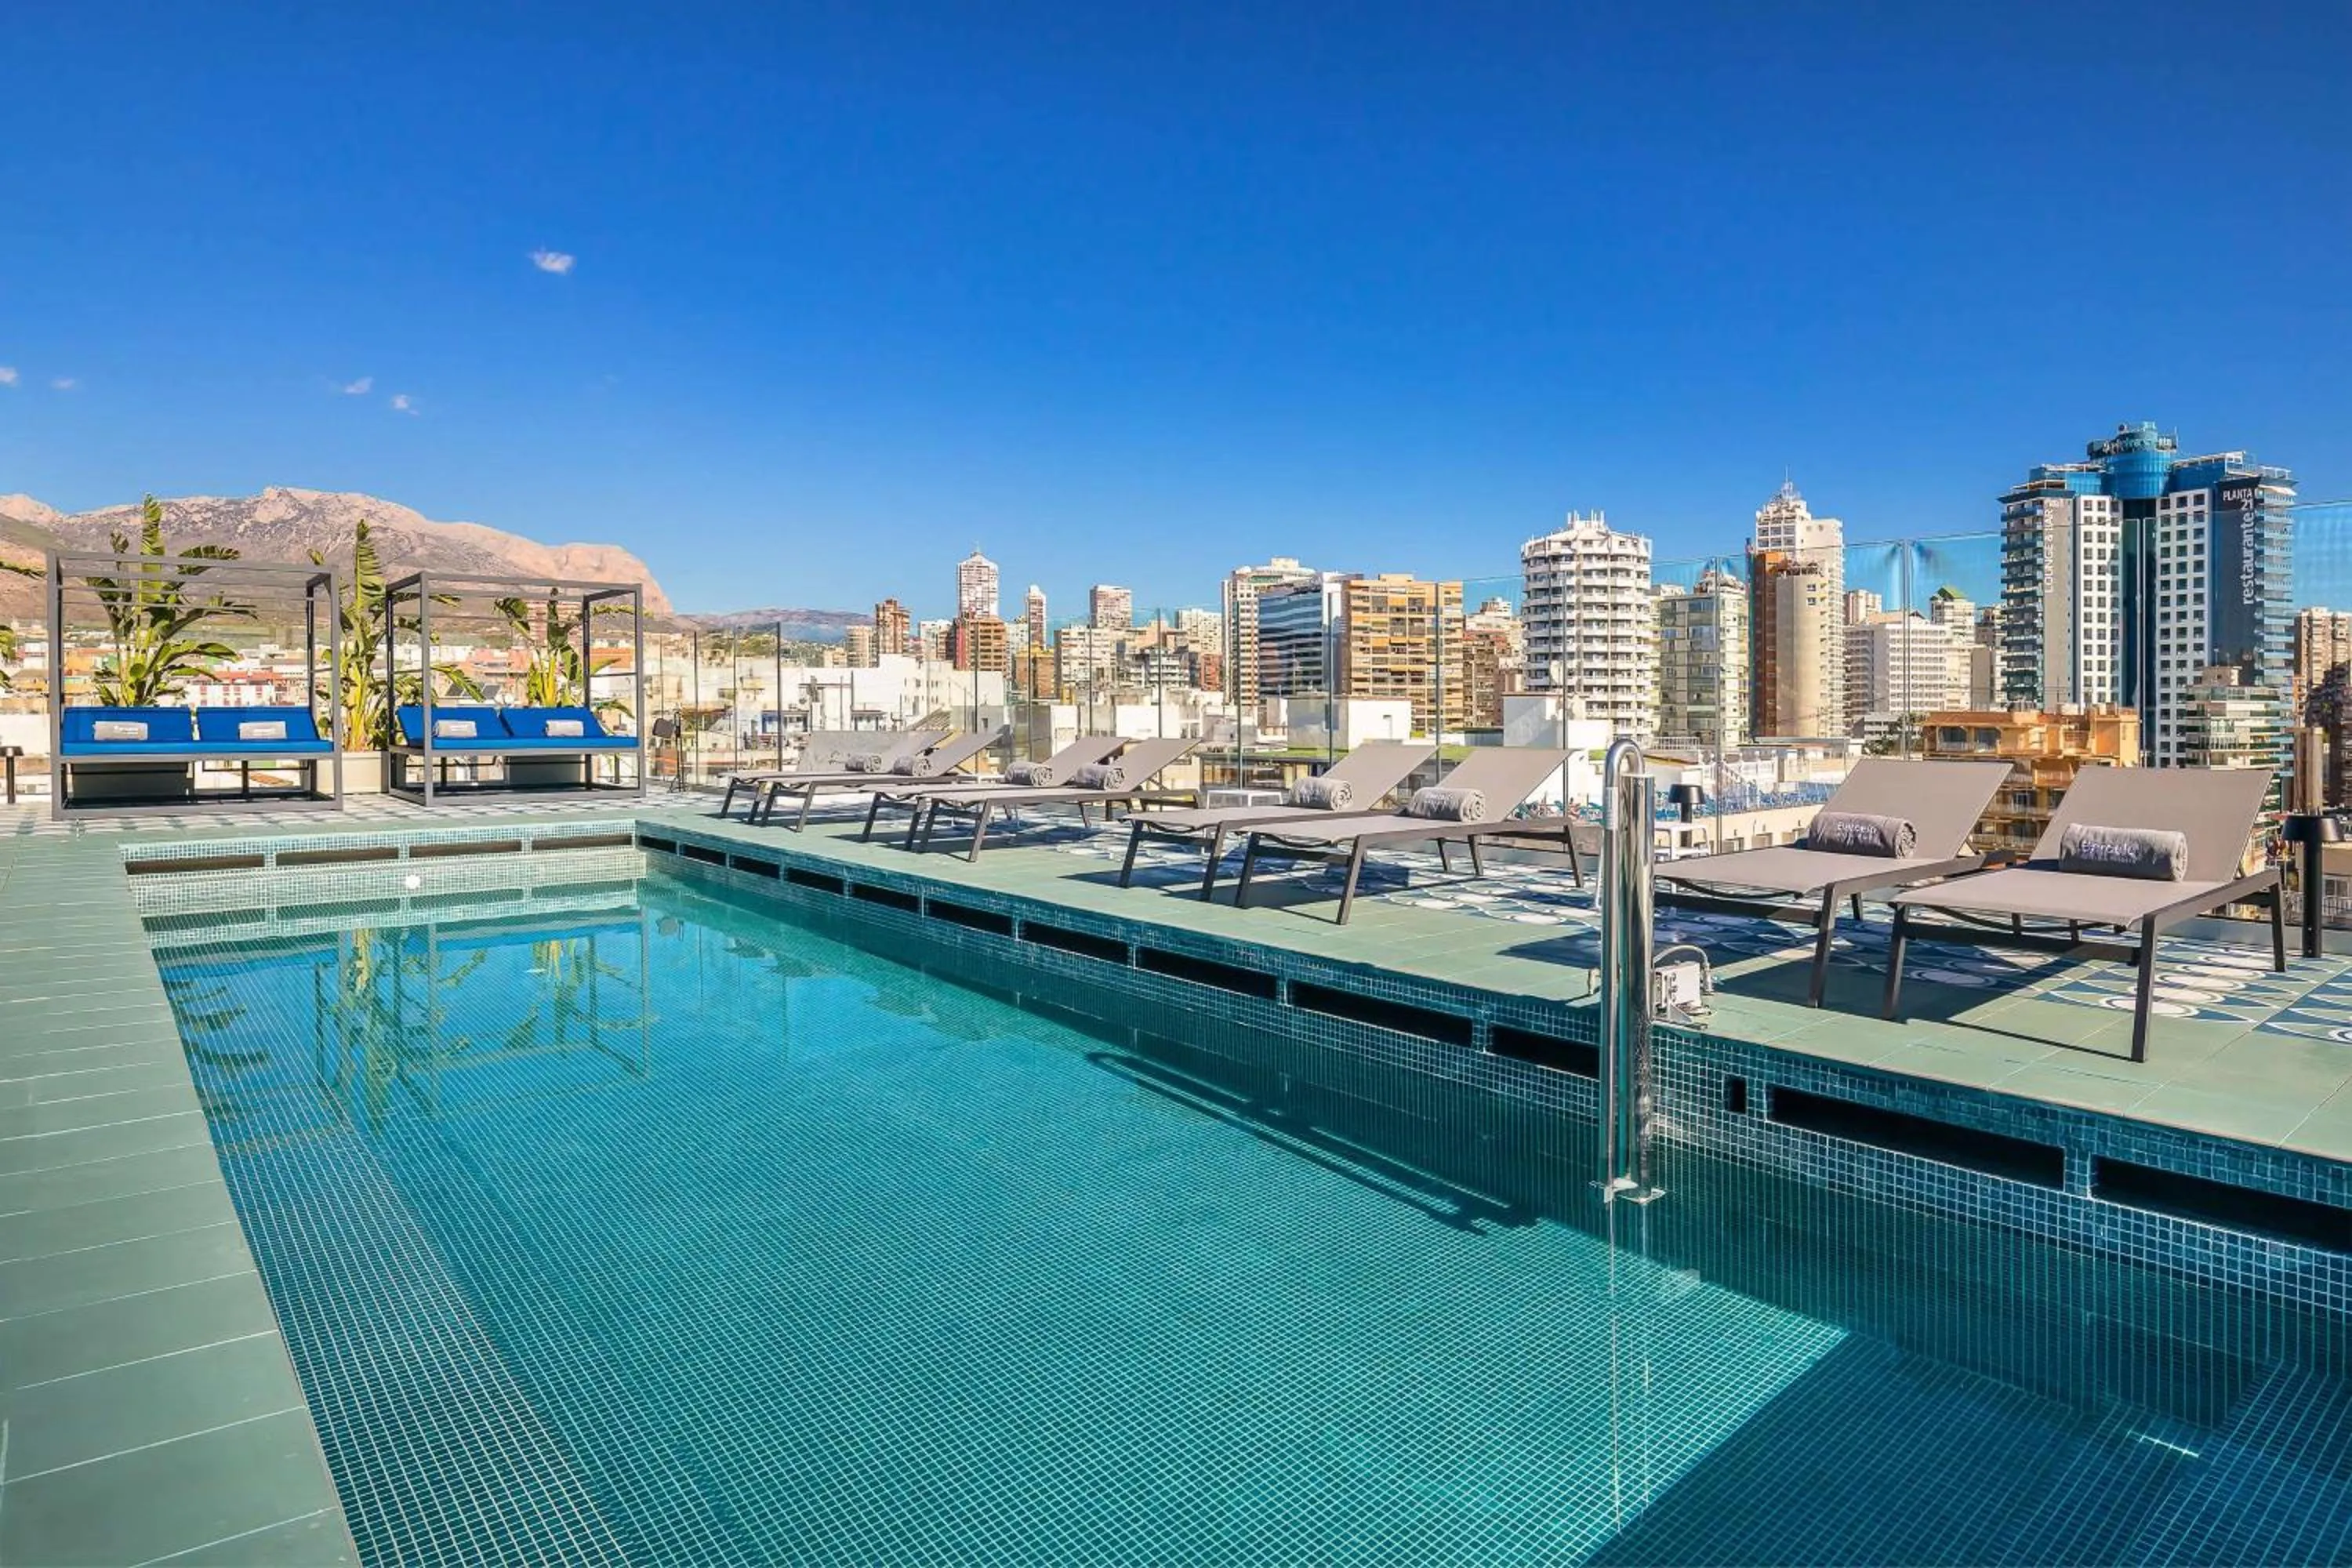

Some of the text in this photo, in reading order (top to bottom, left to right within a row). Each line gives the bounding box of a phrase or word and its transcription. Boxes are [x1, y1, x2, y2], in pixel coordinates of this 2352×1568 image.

[2223, 488, 2252, 501] PLANTA
[2044, 542, 2053, 593] LOUNGE
[2240, 511, 2254, 605] restaurante
